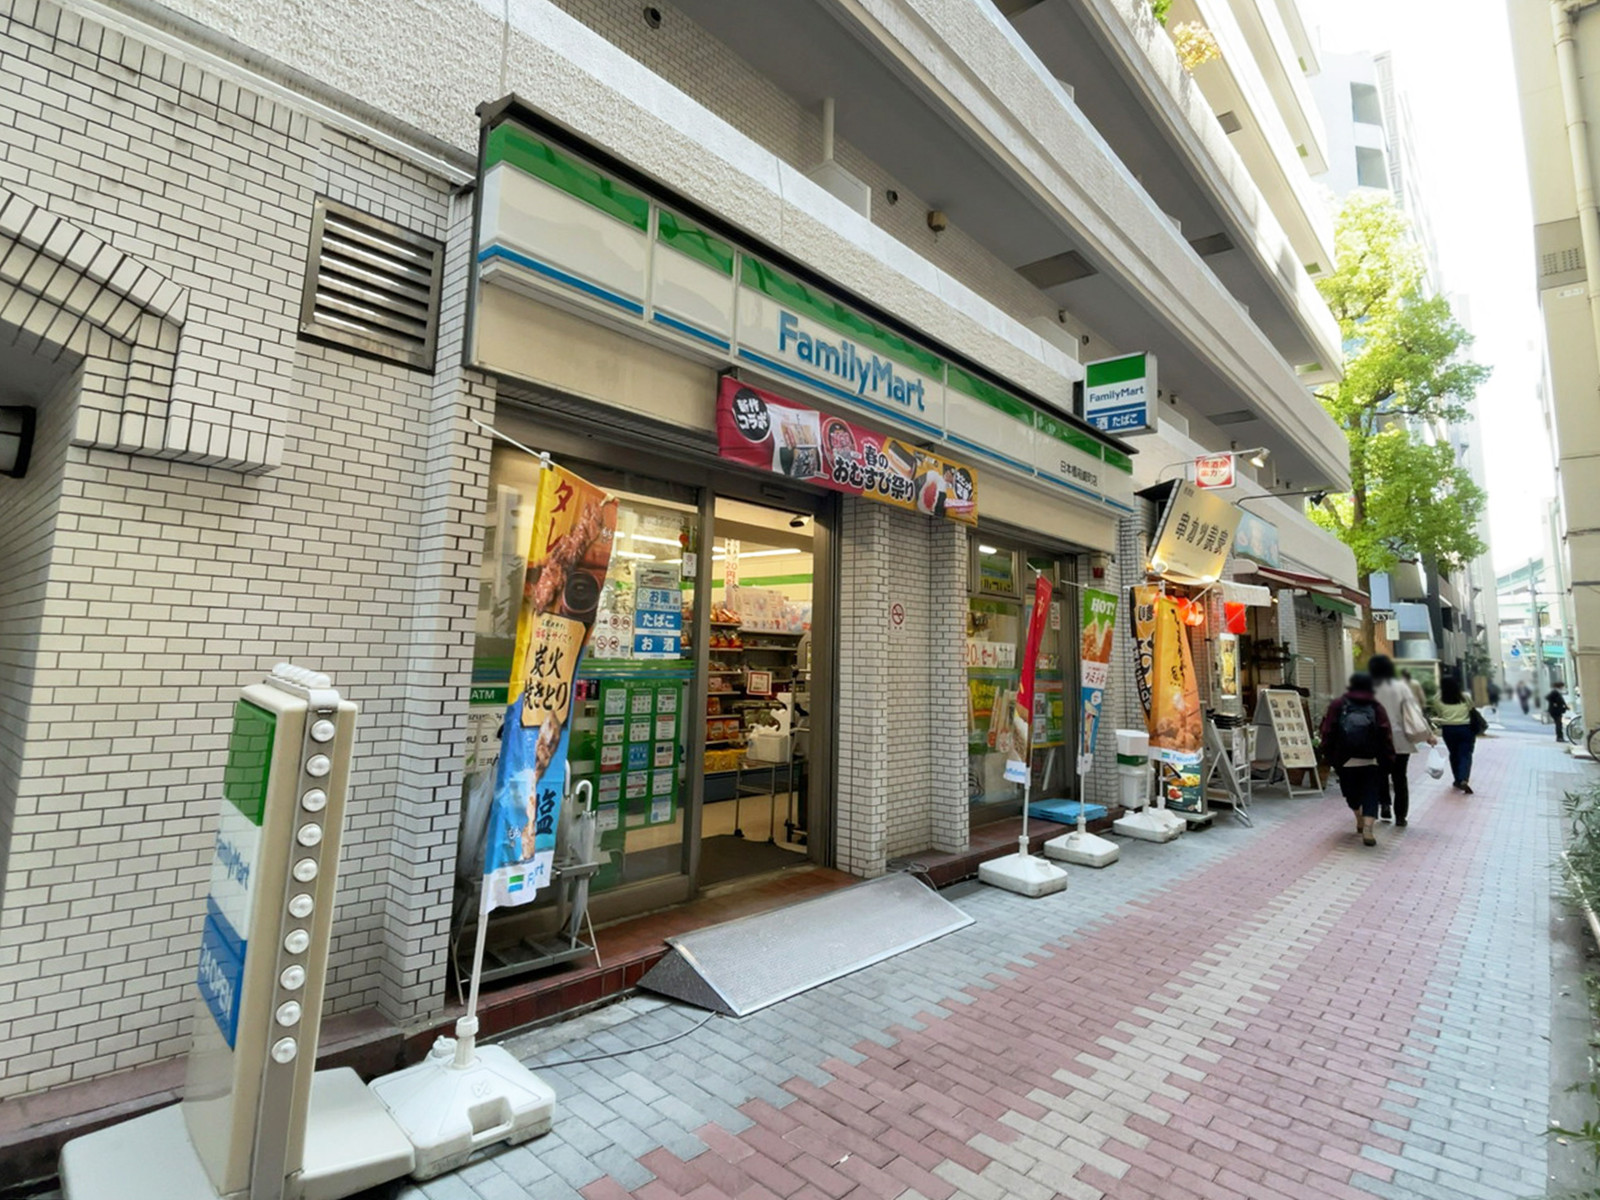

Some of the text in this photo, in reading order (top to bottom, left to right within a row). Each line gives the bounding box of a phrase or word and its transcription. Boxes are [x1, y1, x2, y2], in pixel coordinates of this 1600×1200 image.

[778, 310, 925, 412] FamilyMart
[1090, 386, 1144, 403] FamilyMart
[737, 411, 769, 430] コラボ
[1112, 413, 1138, 427] たばこ
[864, 444, 889, 471] 春の
[833, 455, 915, 502] おむすび祭り
[546, 479, 574, 554] タレ
[1091, 597, 1115, 616] HOT!
[642, 613, 675, 628] たばこ
[530, 643, 563, 679] 炭火
[471, 689, 495, 700] ATM
[524, 678, 568, 711] 焼きとり
